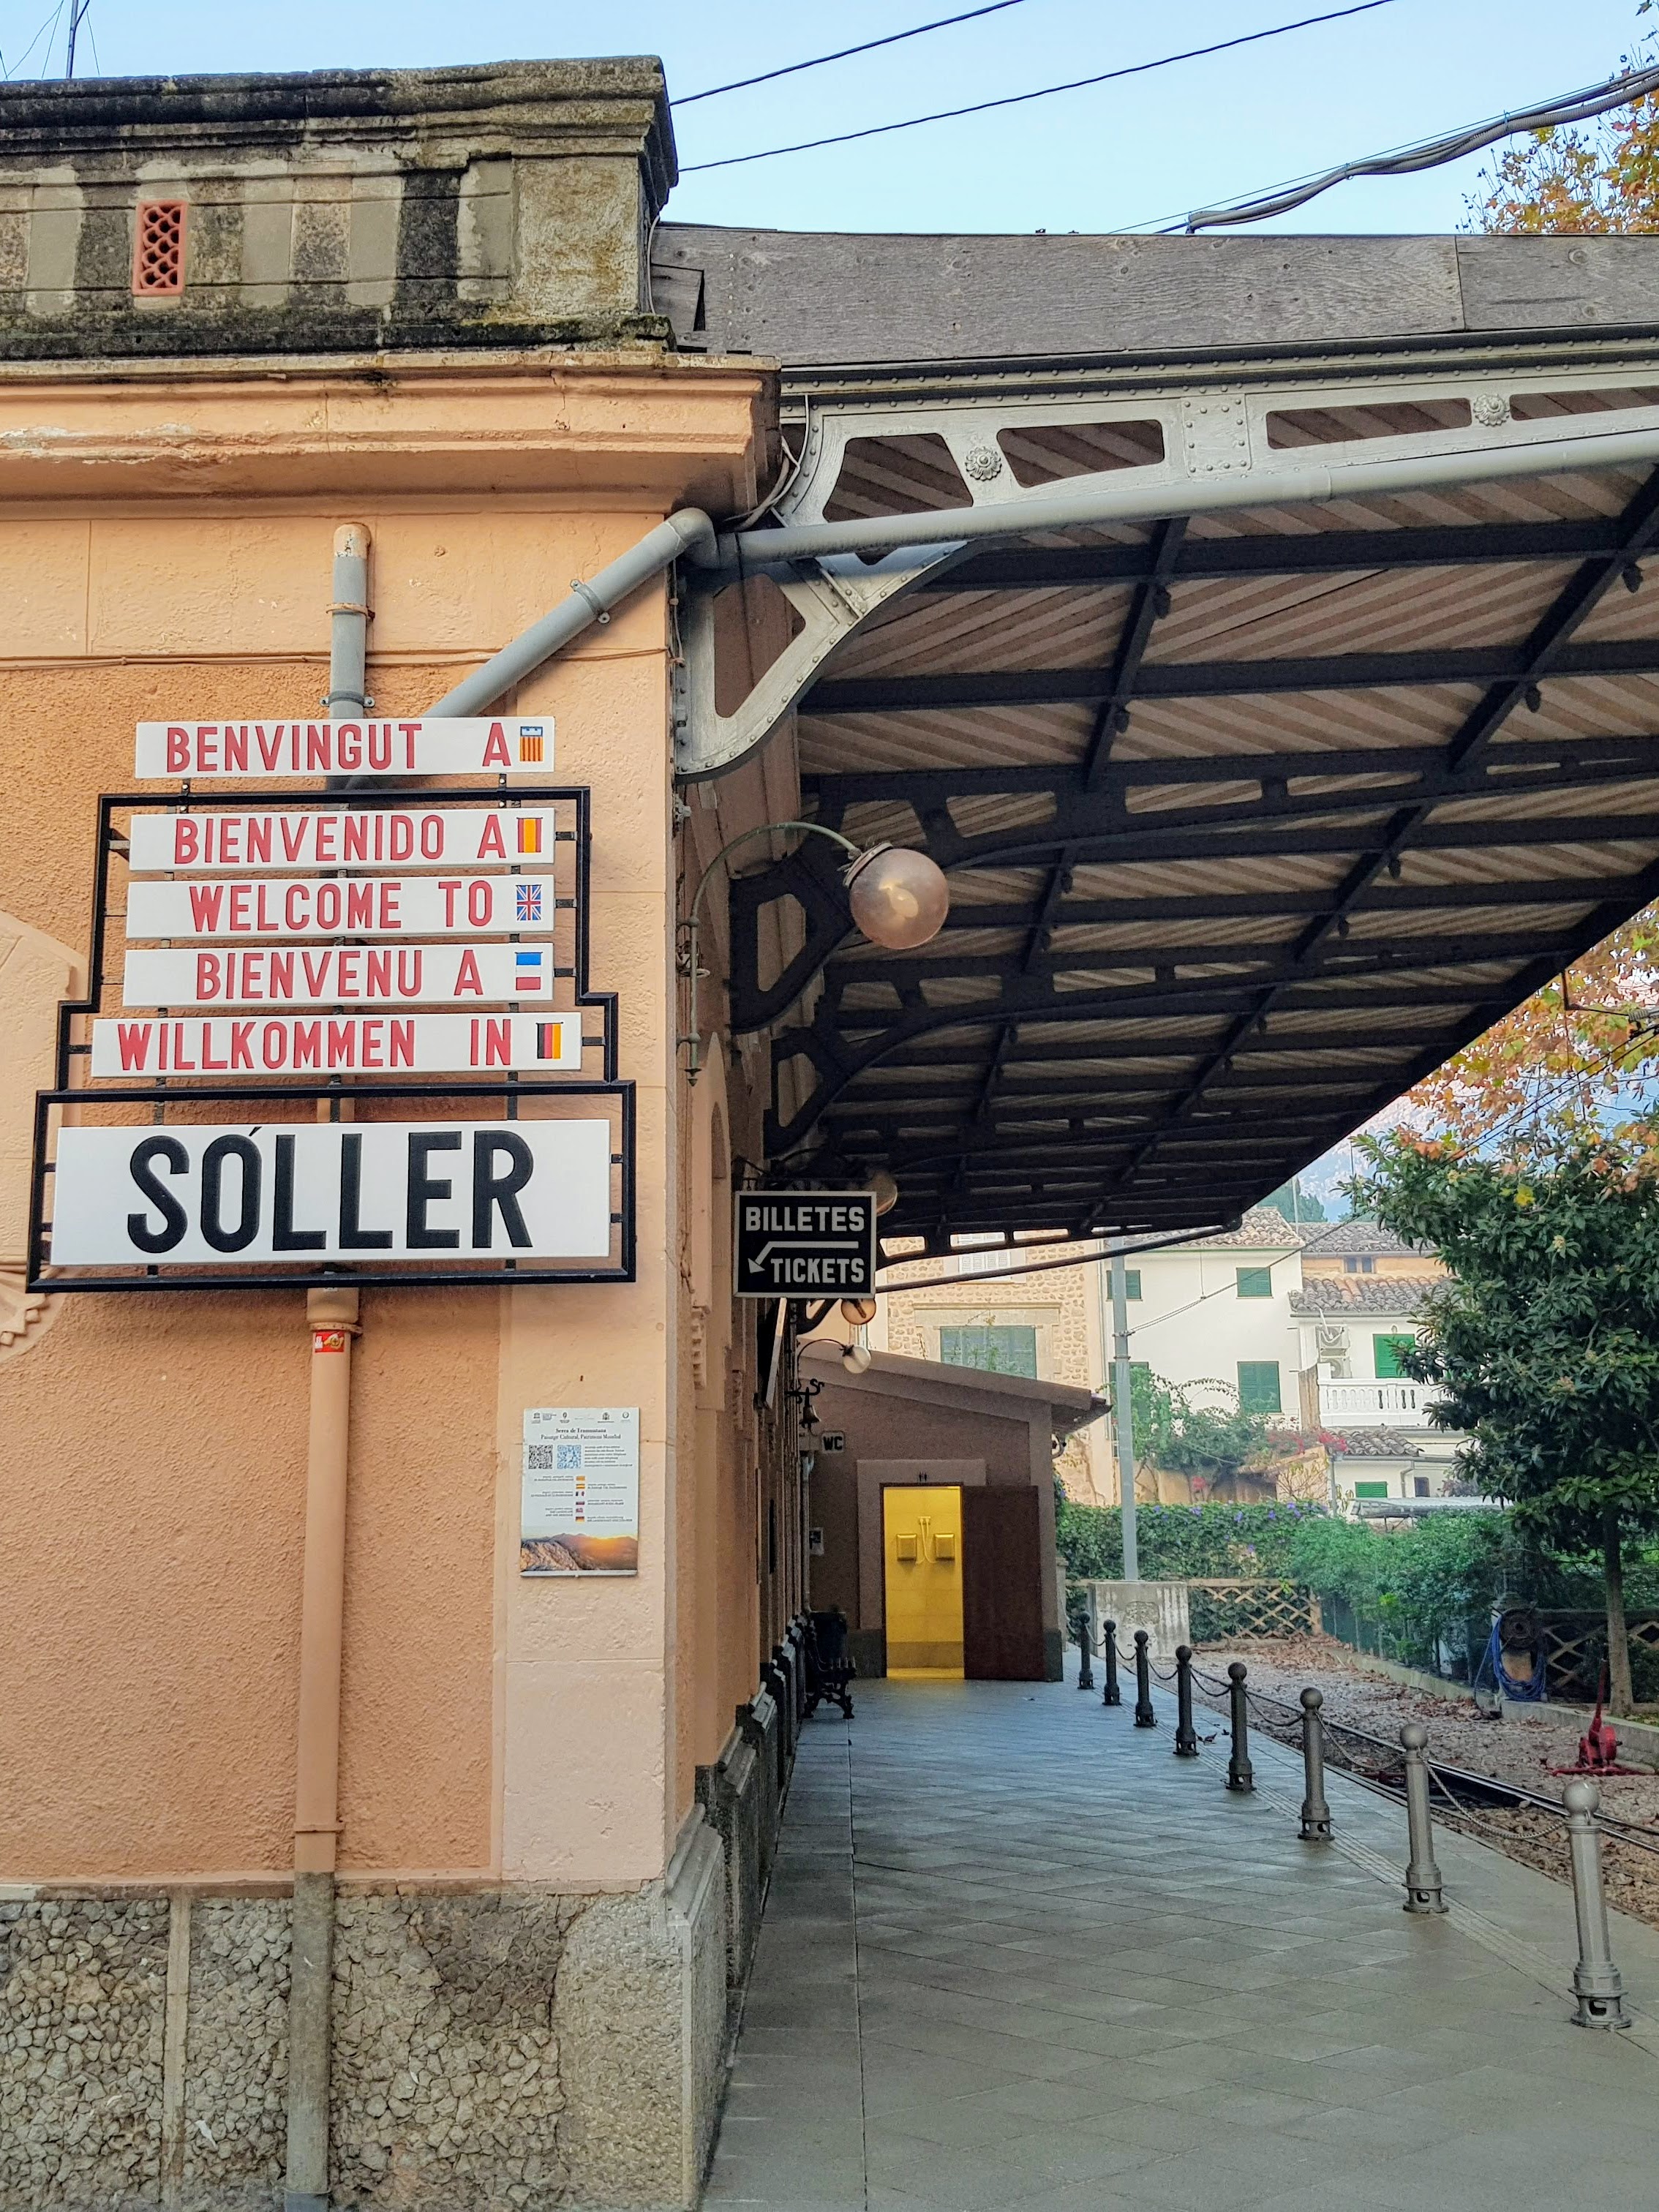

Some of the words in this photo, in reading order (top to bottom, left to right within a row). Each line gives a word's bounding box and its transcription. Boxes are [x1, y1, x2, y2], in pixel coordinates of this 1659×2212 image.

[167, 723, 423, 773] BENVINGUT
[483, 723, 511, 767] A
[174, 815, 445, 865] BIENVENIDO
[478, 814, 506, 859] A
[189, 882, 402, 933] WELCOME
[438, 880, 494, 928] TO
[196, 950, 423, 1001] BIENVENU
[454, 950, 484, 996] A
[118, 1020, 415, 1072] WILLKOMMEN
[470, 1019, 512, 1066] IN
[126, 1125, 534, 1253] SÓLLER
[745, 1206, 865, 1232] BILLETES
[770, 1257, 865, 1284] TICKETS
[823, 1435, 843, 1451] WC
